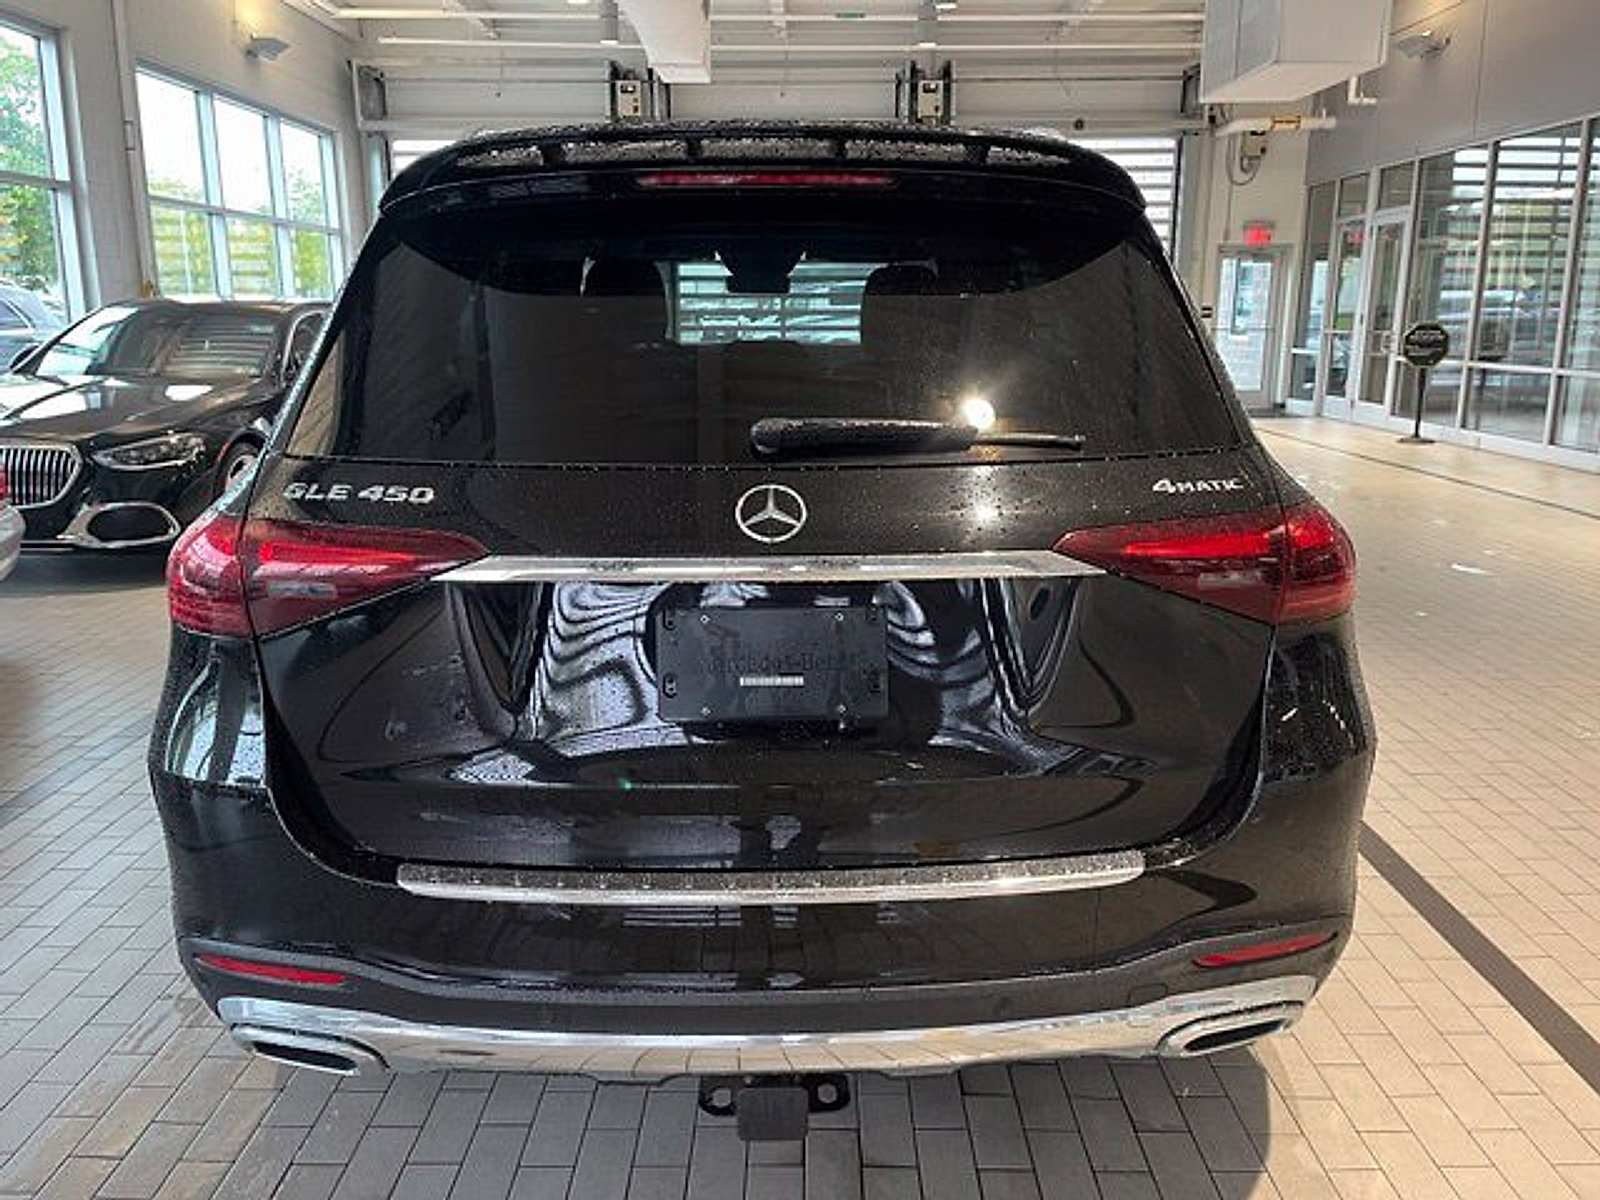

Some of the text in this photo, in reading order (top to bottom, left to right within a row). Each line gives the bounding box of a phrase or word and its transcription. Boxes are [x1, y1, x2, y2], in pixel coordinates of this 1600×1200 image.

[283, 482, 435, 504] GLE 450
[1151, 478, 1244, 494] 4MATIC
